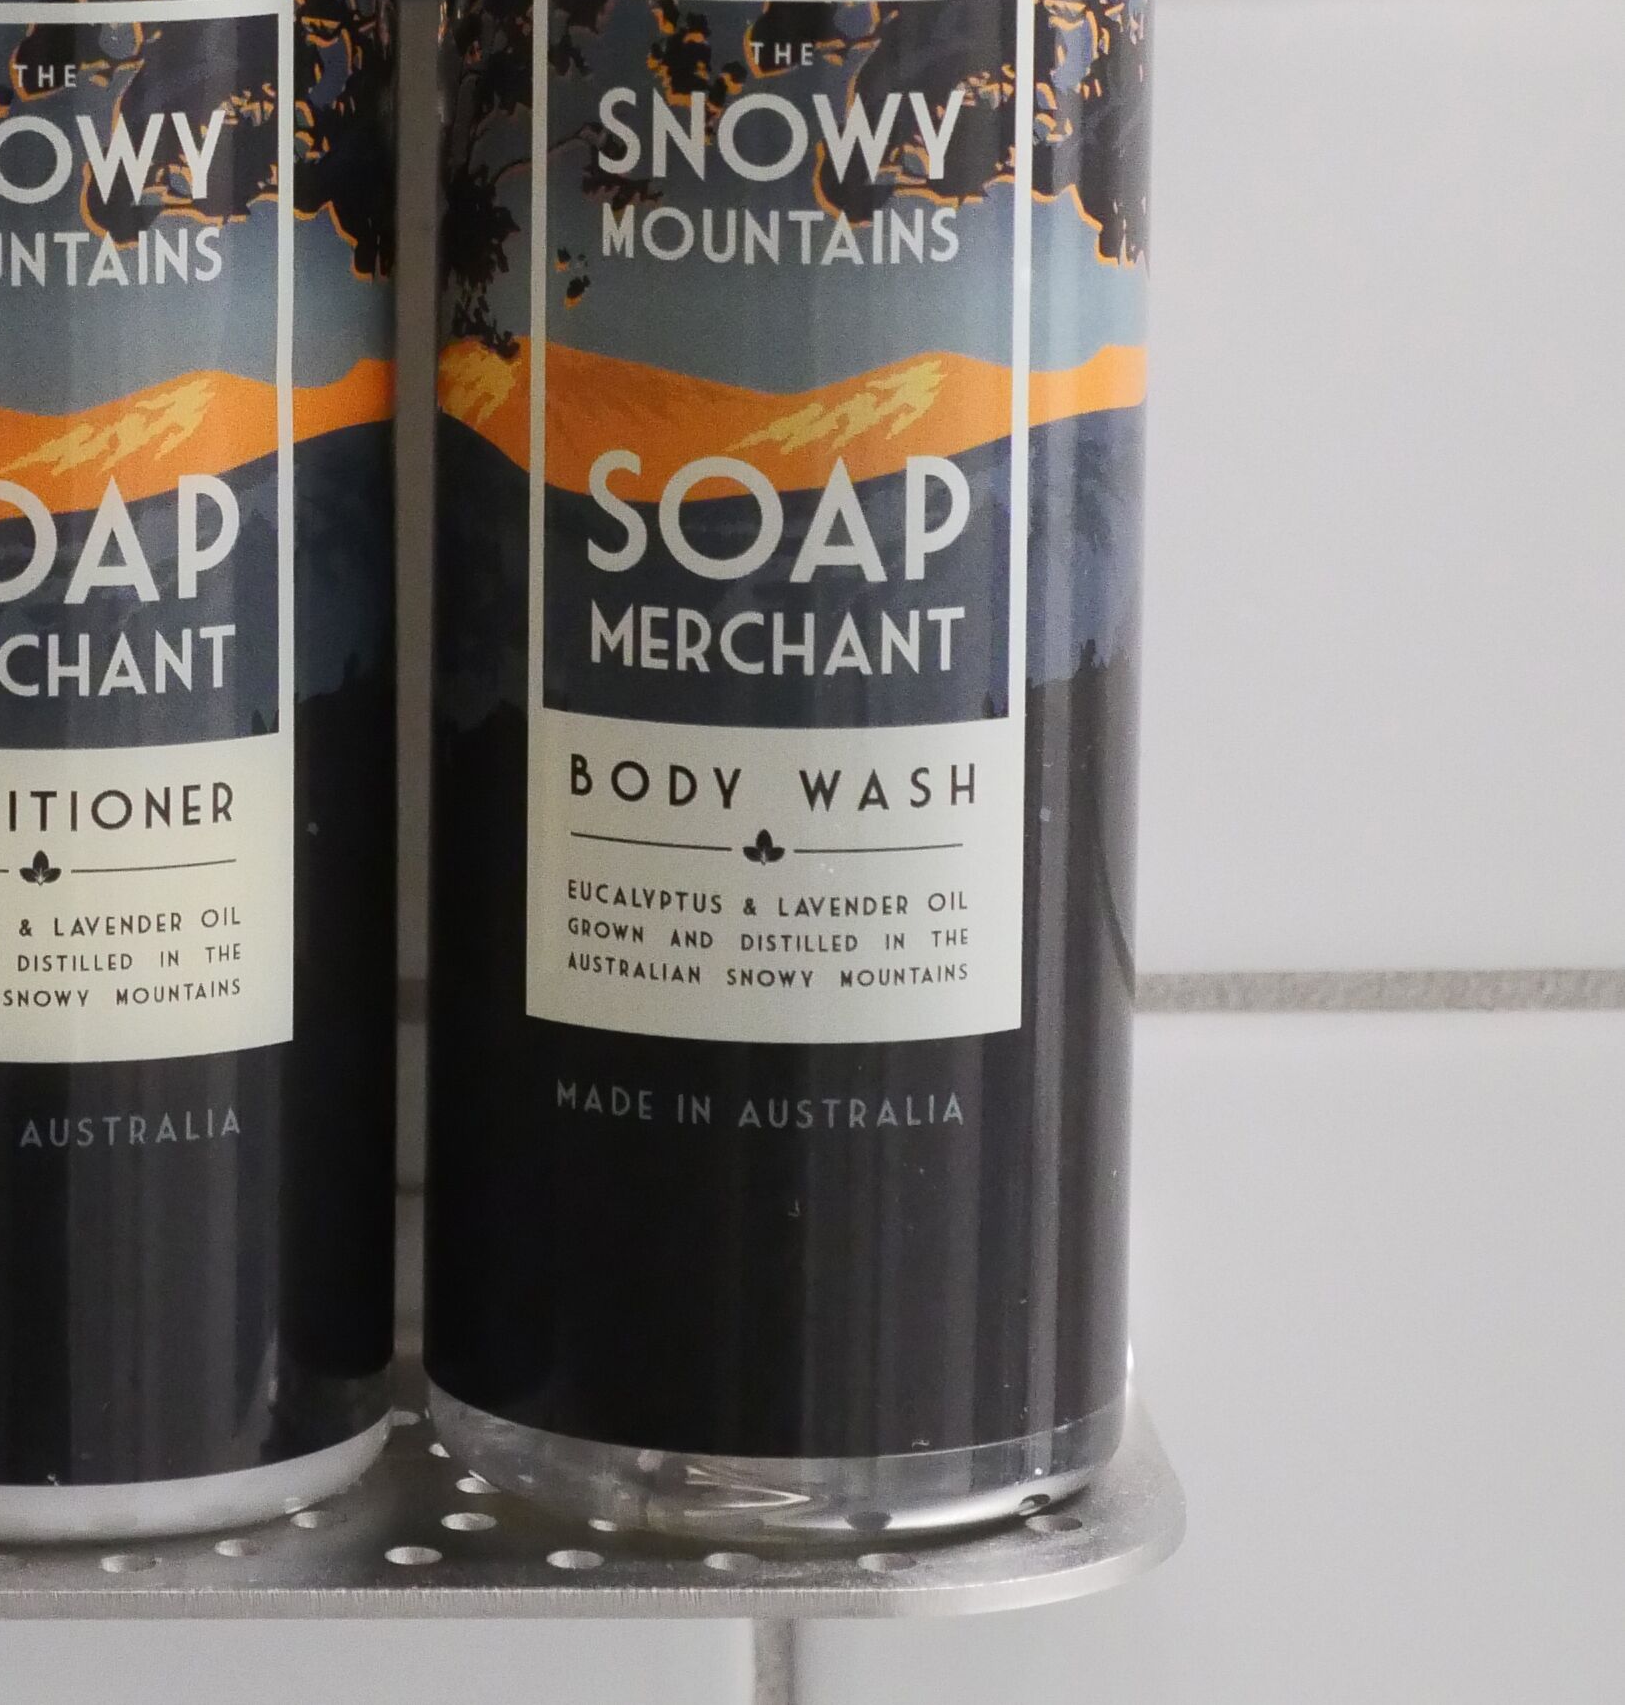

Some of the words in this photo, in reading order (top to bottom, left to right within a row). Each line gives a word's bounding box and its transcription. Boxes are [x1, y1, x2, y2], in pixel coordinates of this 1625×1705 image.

[749, 40, 815, 67] THE
[13, 63, 78, 88] THE
[596, 86, 966, 184] SNOWY
[601, 203, 961, 266] MOUNTAINS
[586, 448, 972, 583] SOAP
[590, 598, 967, 677] MERCHANT
[569, 752, 743, 810] BODY
[798, 762, 976, 812] WASH
[567, 878, 723, 915] EUCALYPTUS
[742, 896, 758, 917] &
[778, 895, 909, 918] LAVENDER
[927, 890, 969, 913] OIL
[18, 917, 34, 937] &
[53, 912, 183, 937] LAVENDER
[200, 905, 242, 930] OIL
[567, 917, 645, 944] GROWN
[669, 928, 714, 950] AND
[740, 933, 859, 953] DISTILLED
[884, 933, 906, 951] IN
[930, 927, 970, 949] THE
[17, 953, 134, 973] DISTILLED
[159, 949, 181, 969] IN
[204, 942, 242, 964] THE
[567, 952, 702, 984] AUSTRALIAN
[726, 968, 815, 989] SNOWY
[839, 962, 969, 988] MOUNTAINS
[2, 989, 90, 1009] SNOWY
[115, 977, 242, 1006] MOUNTAINS
[556, 1078, 653, 1121] MADE
[676, 1093, 712, 1125] IN
[737, 1092, 965, 1130] AUSTRALIA
[19, 1106, 242, 1148] AUSTRALIA
